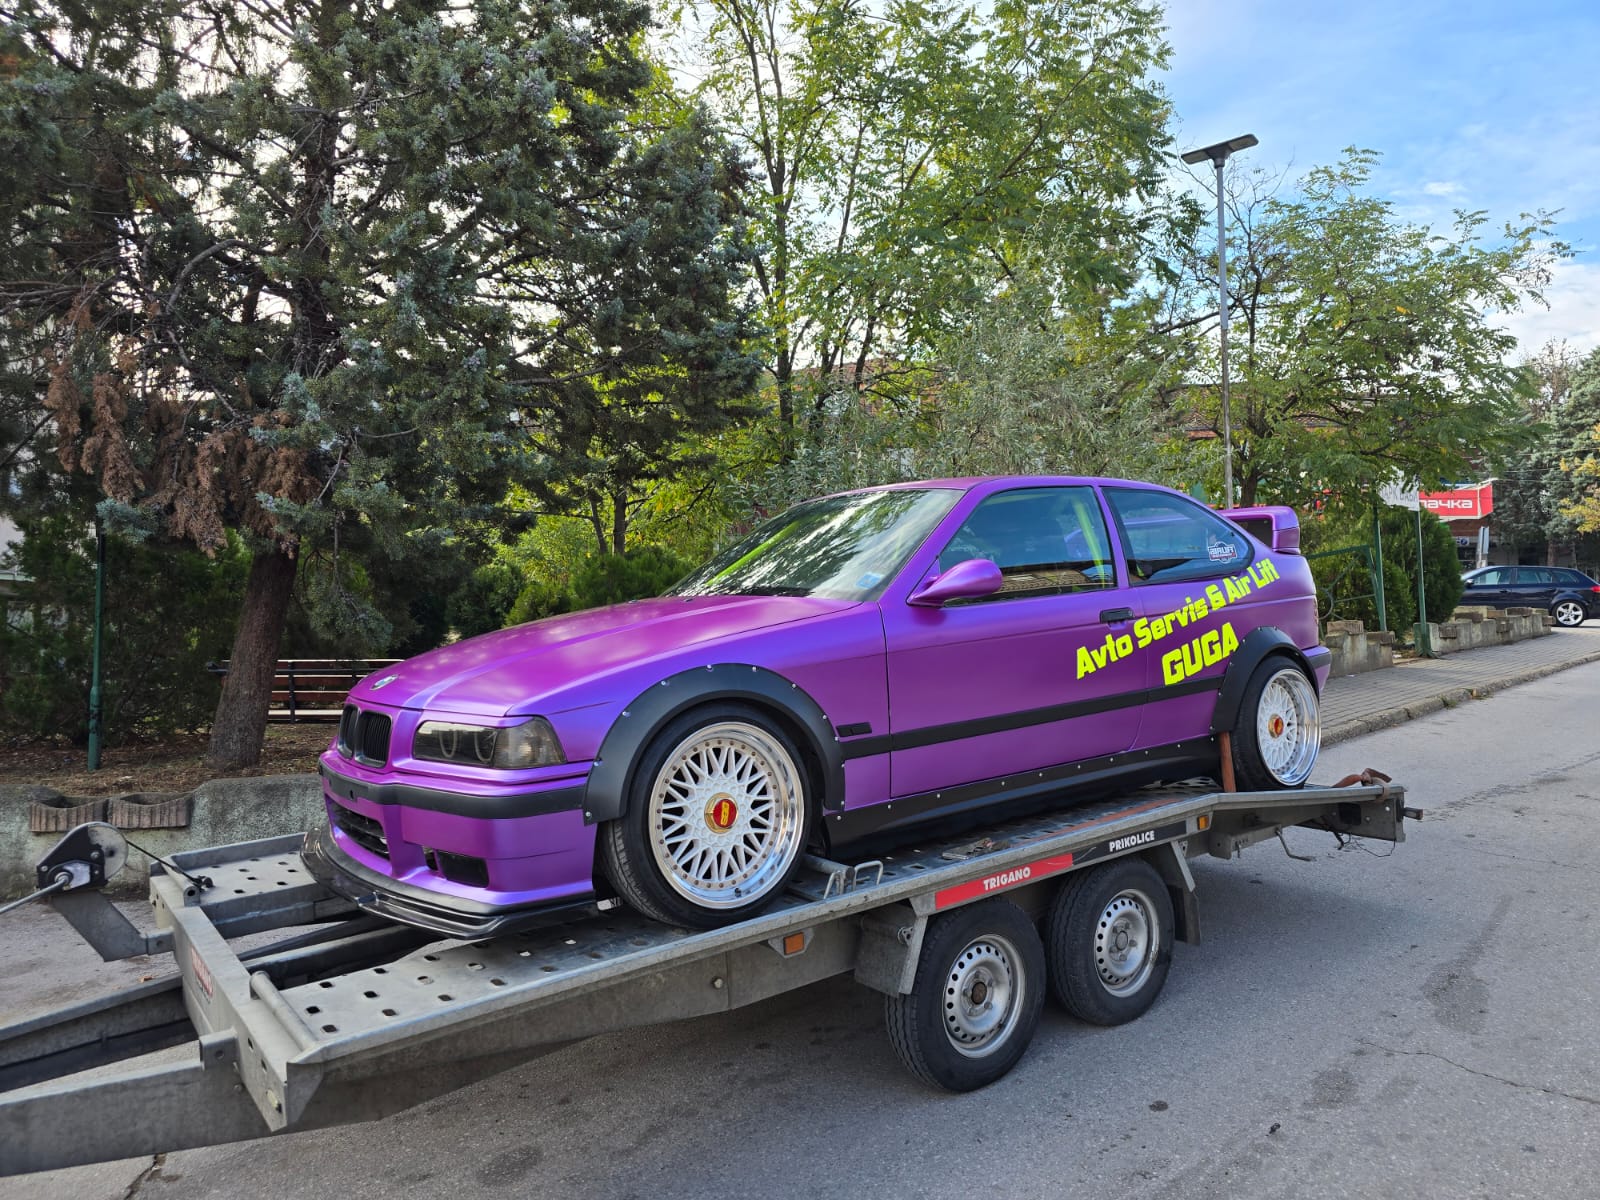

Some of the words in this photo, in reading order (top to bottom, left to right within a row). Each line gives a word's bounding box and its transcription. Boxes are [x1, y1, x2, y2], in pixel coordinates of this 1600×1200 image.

[1076, 633, 1134, 680] Avto
[1133, 596, 1209, 649] Servis
[1222, 575, 1252, 604] Air
[1247, 557, 1281, 589] Lift
[1161, 621, 1240, 687] GUGA
[1109, 829, 1155, 853] PRIKOLICE
[983, 866, 1031, 891] TRIGANO
